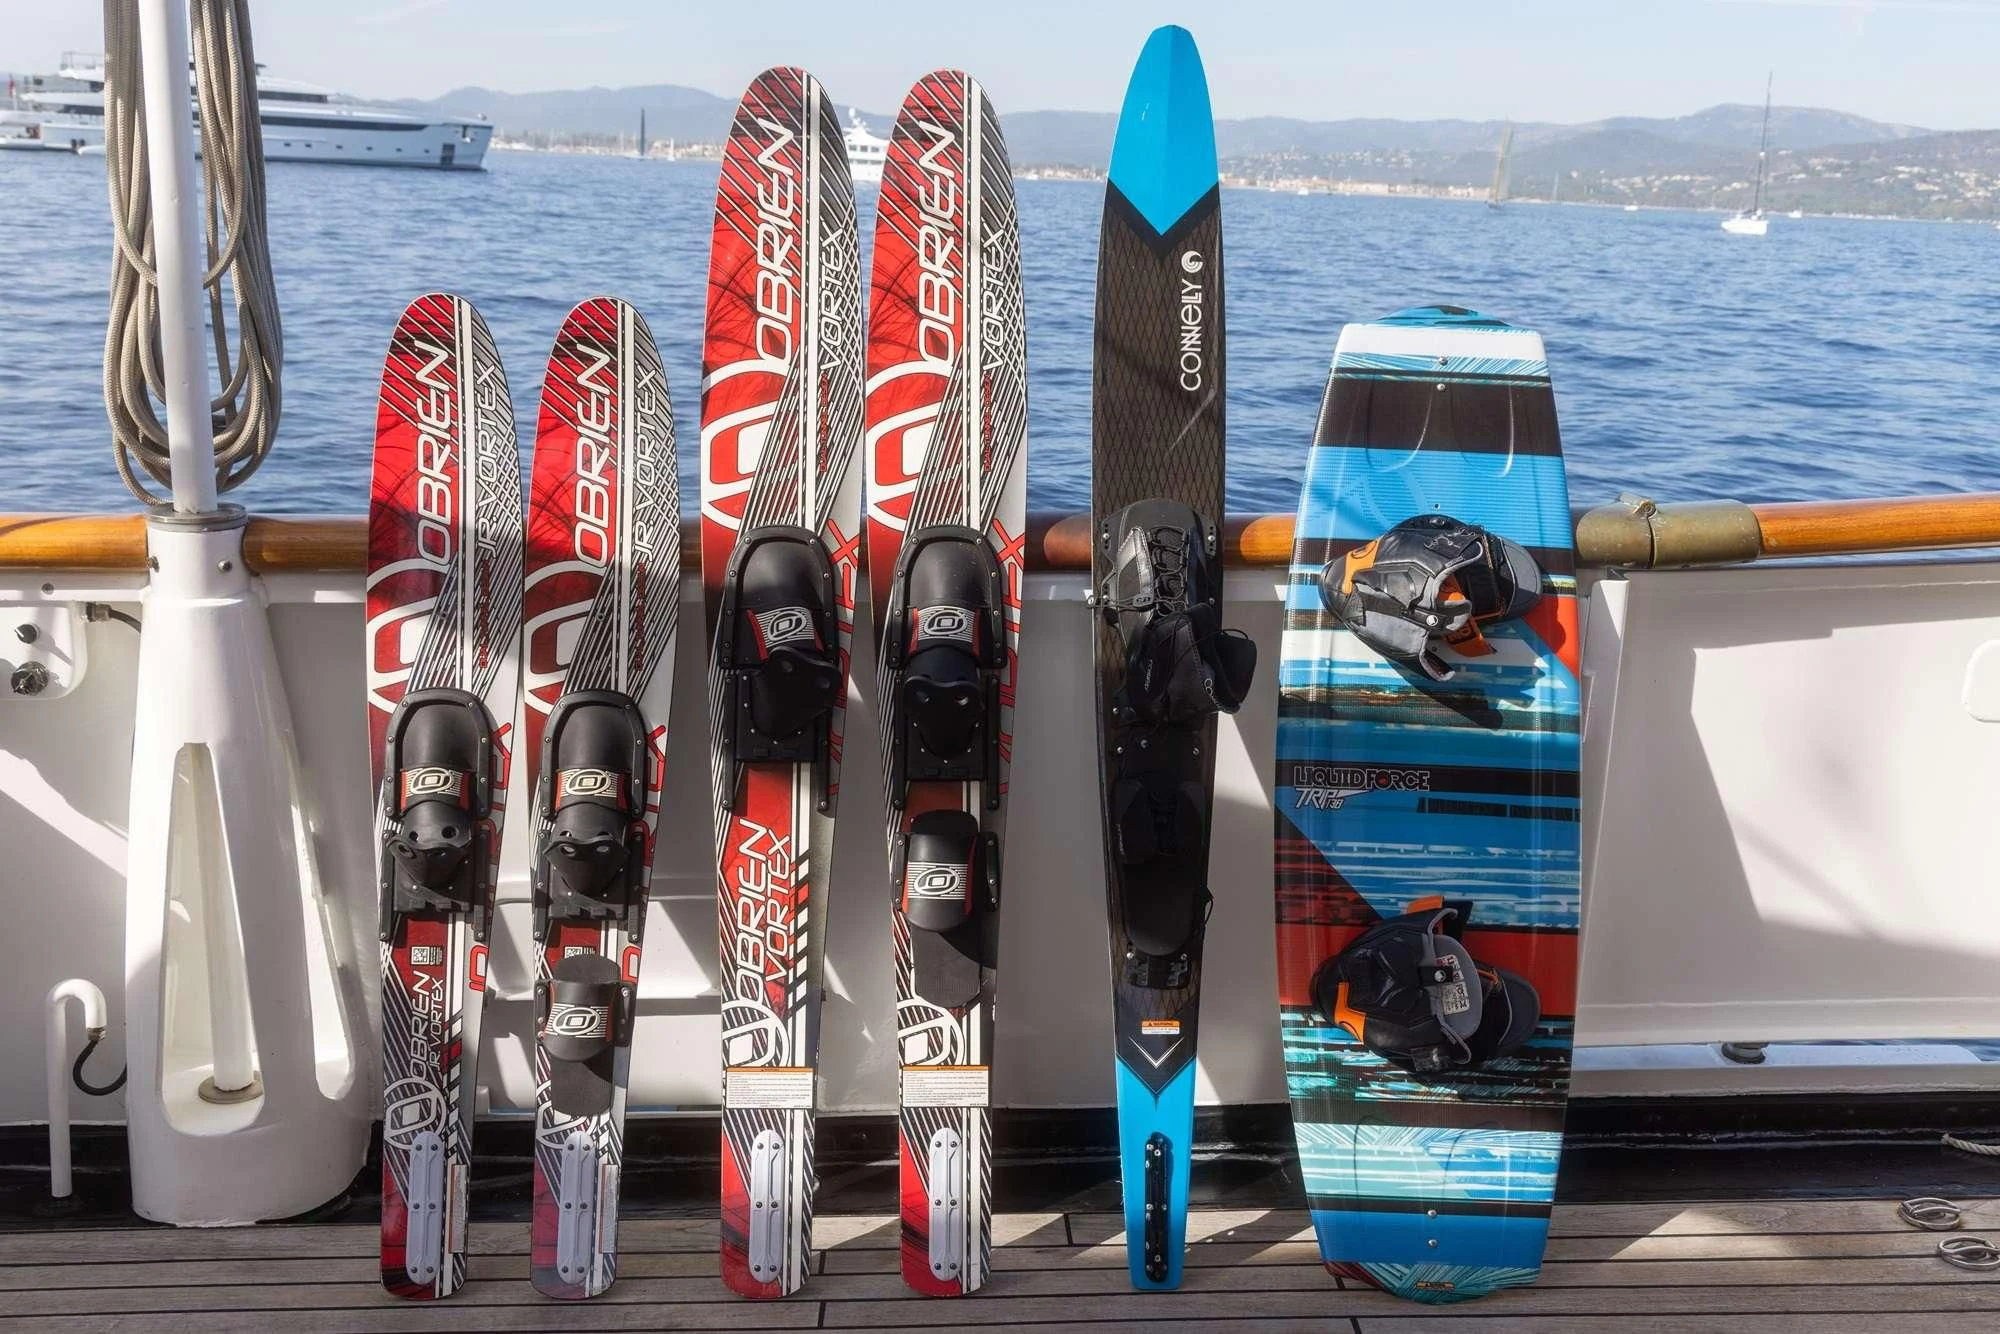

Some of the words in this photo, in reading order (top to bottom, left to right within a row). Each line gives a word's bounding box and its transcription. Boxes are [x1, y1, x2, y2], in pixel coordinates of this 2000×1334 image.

[756, 119, 794, 364] OBRIEN
[820, 227, 845, 369] VORTEX
[919, 121, 956, 366] OBRIEN
[982, 228, 1007, 370] VORTEX
[414, 340, 450, 565] OBRIEN
[474, 360, 499, 508] VORTEX
[575, 343, 611, 567] OBRIEN
[633, 367, 657, 511] VORTEX
[1295, 788, 1340, 810] TRIP
[736, 818, 767, 1003] OBRIEN
[765, 829, 790, 981] VORTEX
[410, 970, 431, 1081] OBRIEN
[430, 977, 444, 1047] VORTEX
